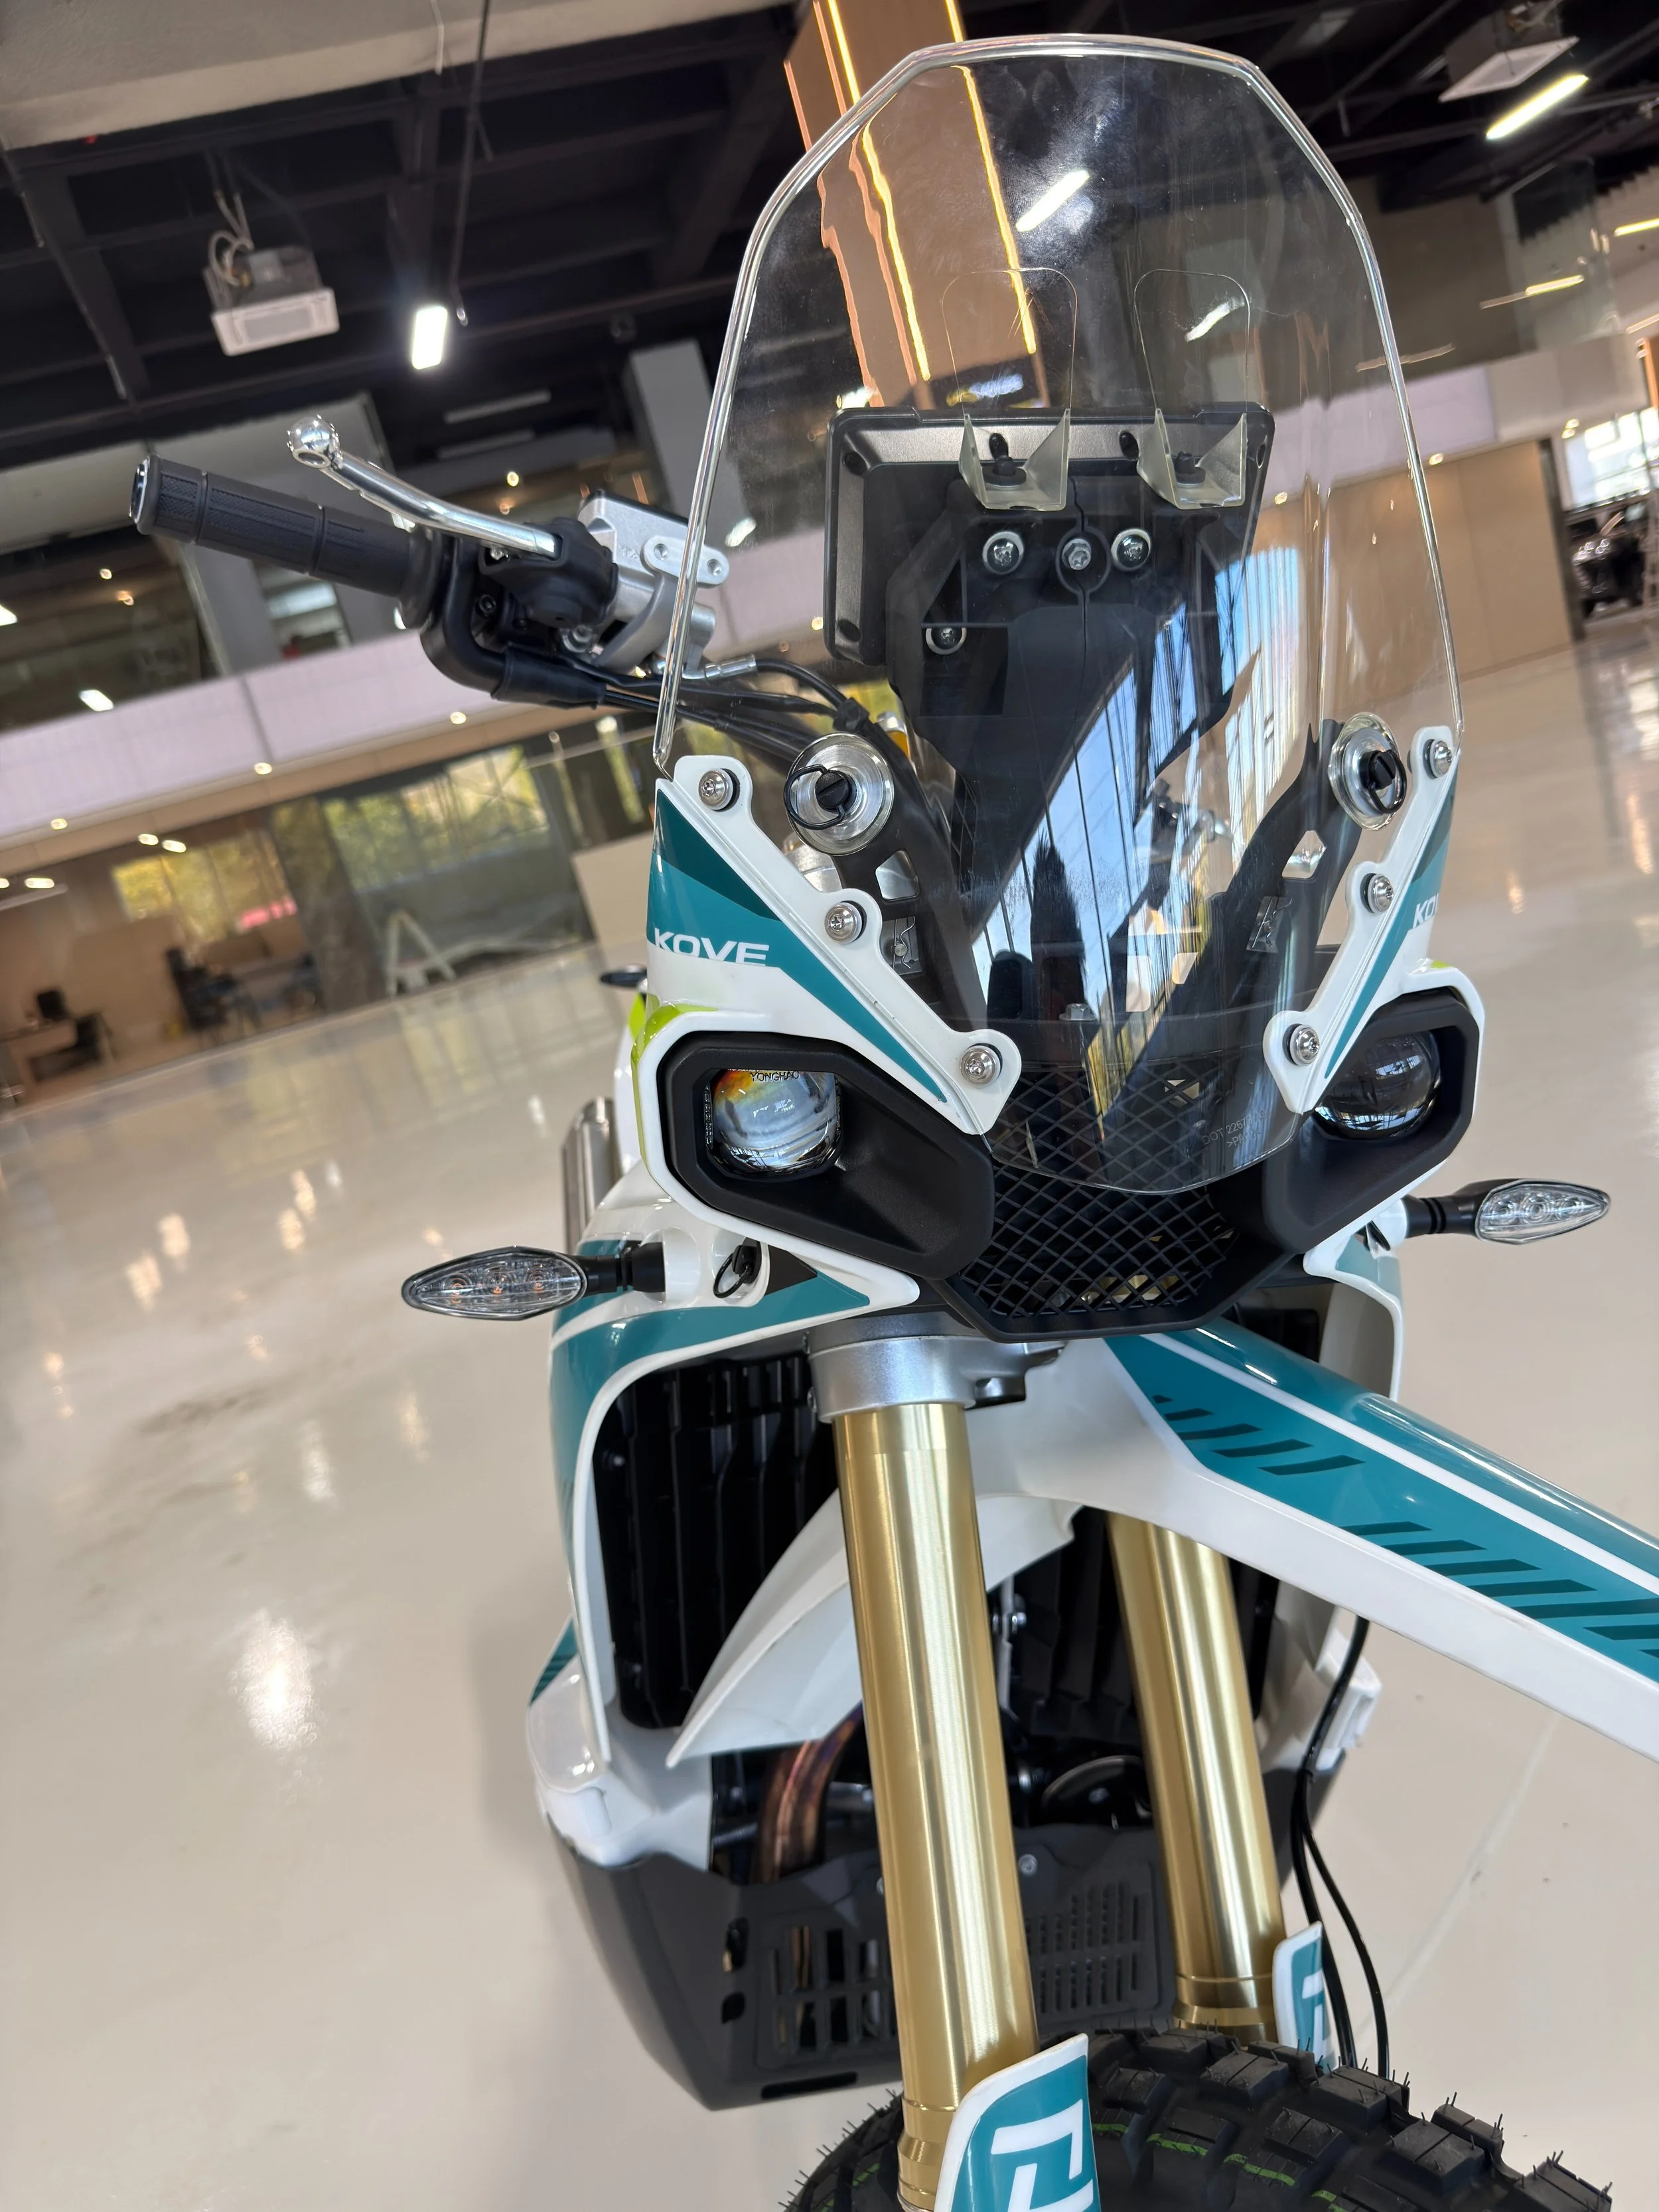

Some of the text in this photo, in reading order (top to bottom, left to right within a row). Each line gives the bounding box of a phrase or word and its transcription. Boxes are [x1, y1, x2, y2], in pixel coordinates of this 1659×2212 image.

[654, 928, 770, 967] KOVE
[750, 1070, 800, 1082] YONGHAO
[1201, 1128, 1224, 1145] DOT
